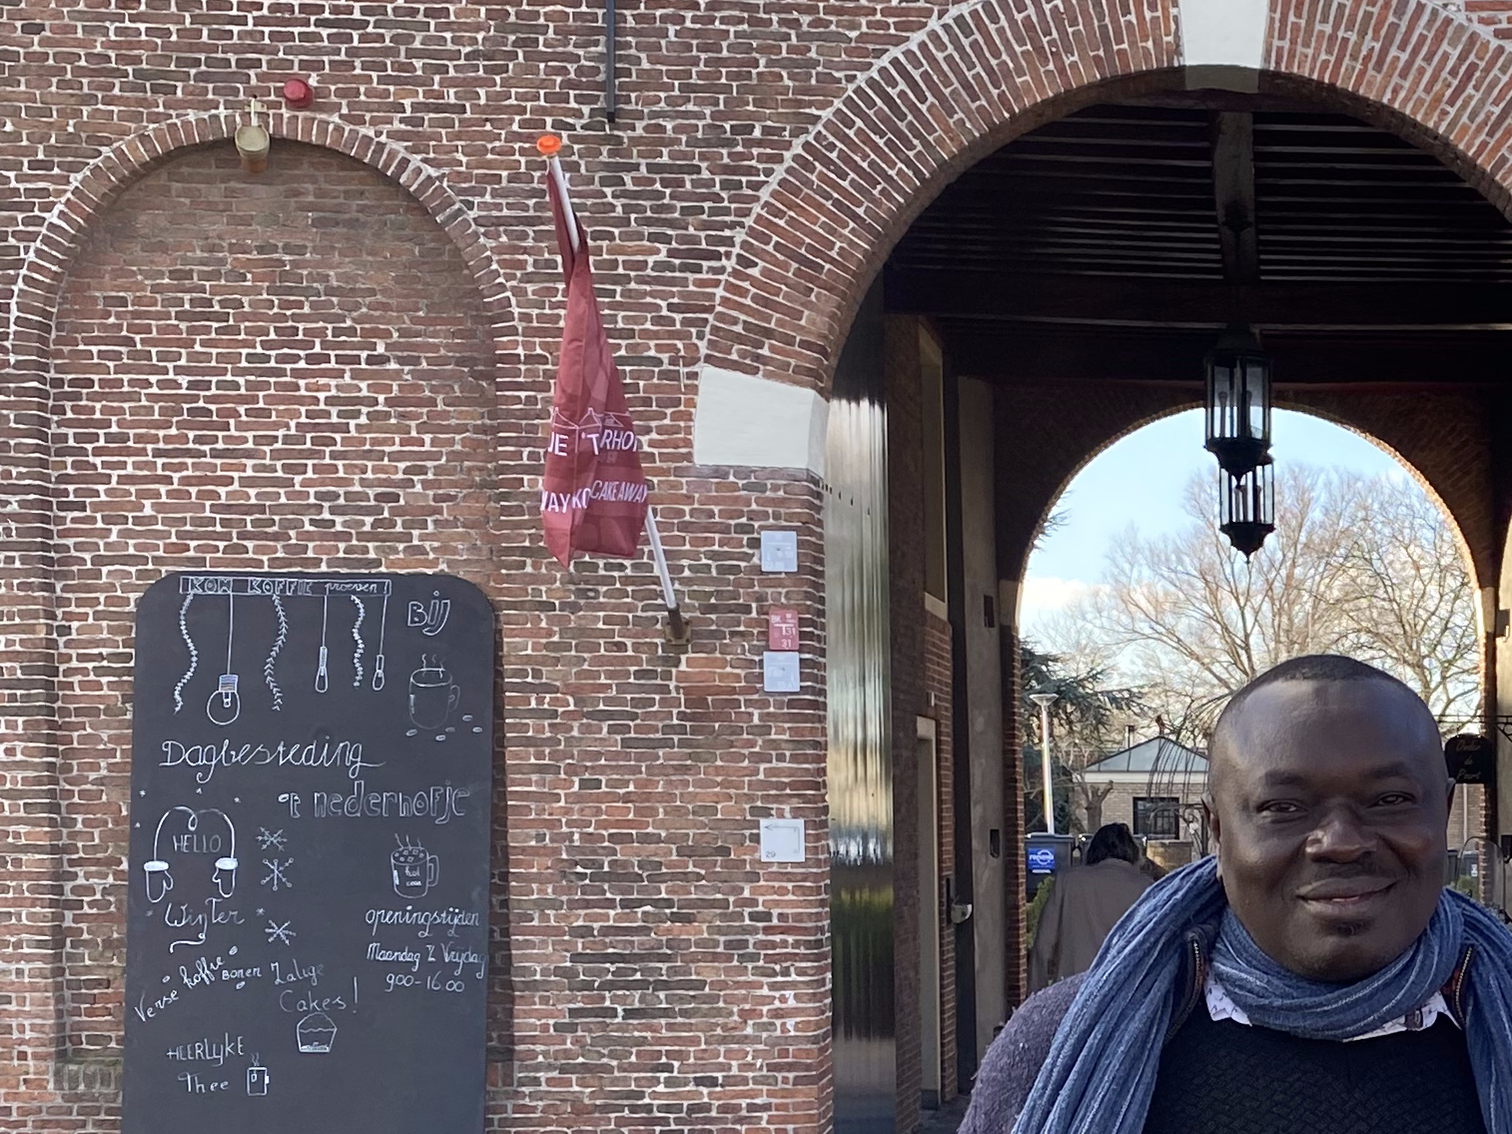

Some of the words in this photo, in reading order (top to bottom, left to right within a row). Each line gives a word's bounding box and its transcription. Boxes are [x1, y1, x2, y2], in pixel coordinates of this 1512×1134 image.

[159, 737, 386, 785] Dagbesteding
[172, 835, 221, 853] HELLO
[164, 897, 245, 945] Winter
[365, 905, 480, 938] openingstijden
[366, 942, 421, 972] Maandag
[441, 941, 486, 979] Vrijdag
[134, 988, 179, 1022] Verse
[177, 1071, 229, 1094] Thee
